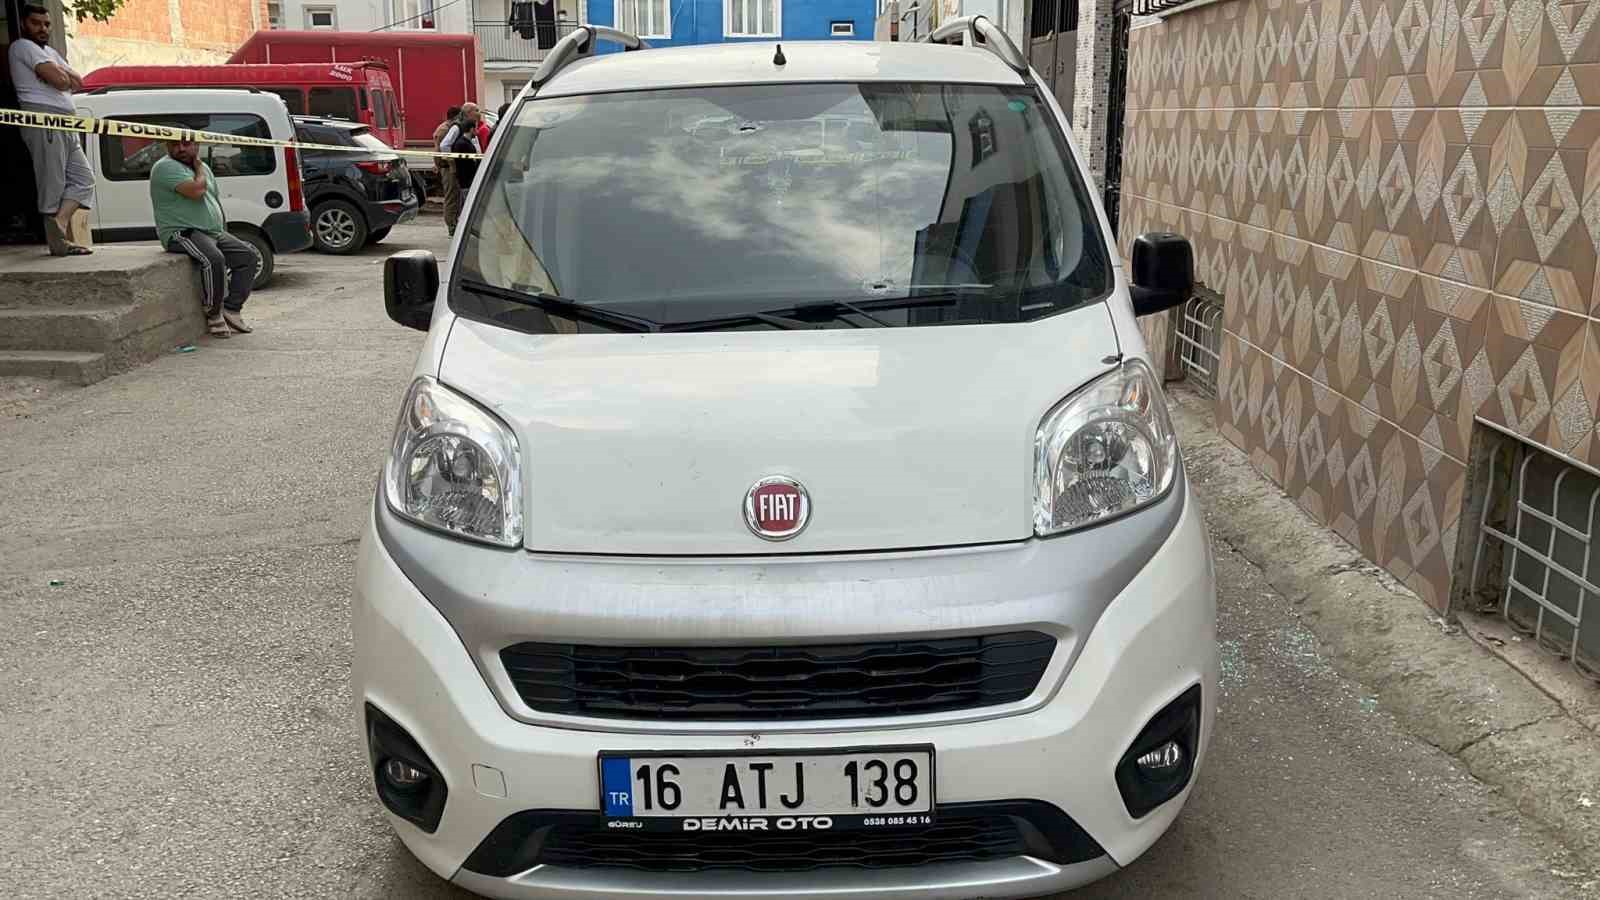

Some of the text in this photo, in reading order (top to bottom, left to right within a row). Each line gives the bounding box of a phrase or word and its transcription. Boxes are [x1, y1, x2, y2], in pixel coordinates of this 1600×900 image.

[760, 493, 797, 521] FIAT
[636, 758, 918, 811] 16 ATJ 138
[608, 791, 629, 806] TR
[776, 816, 833, 830] OTO
[906, 815, 918, 825] 45
[920, 815, 931, 824] 16
